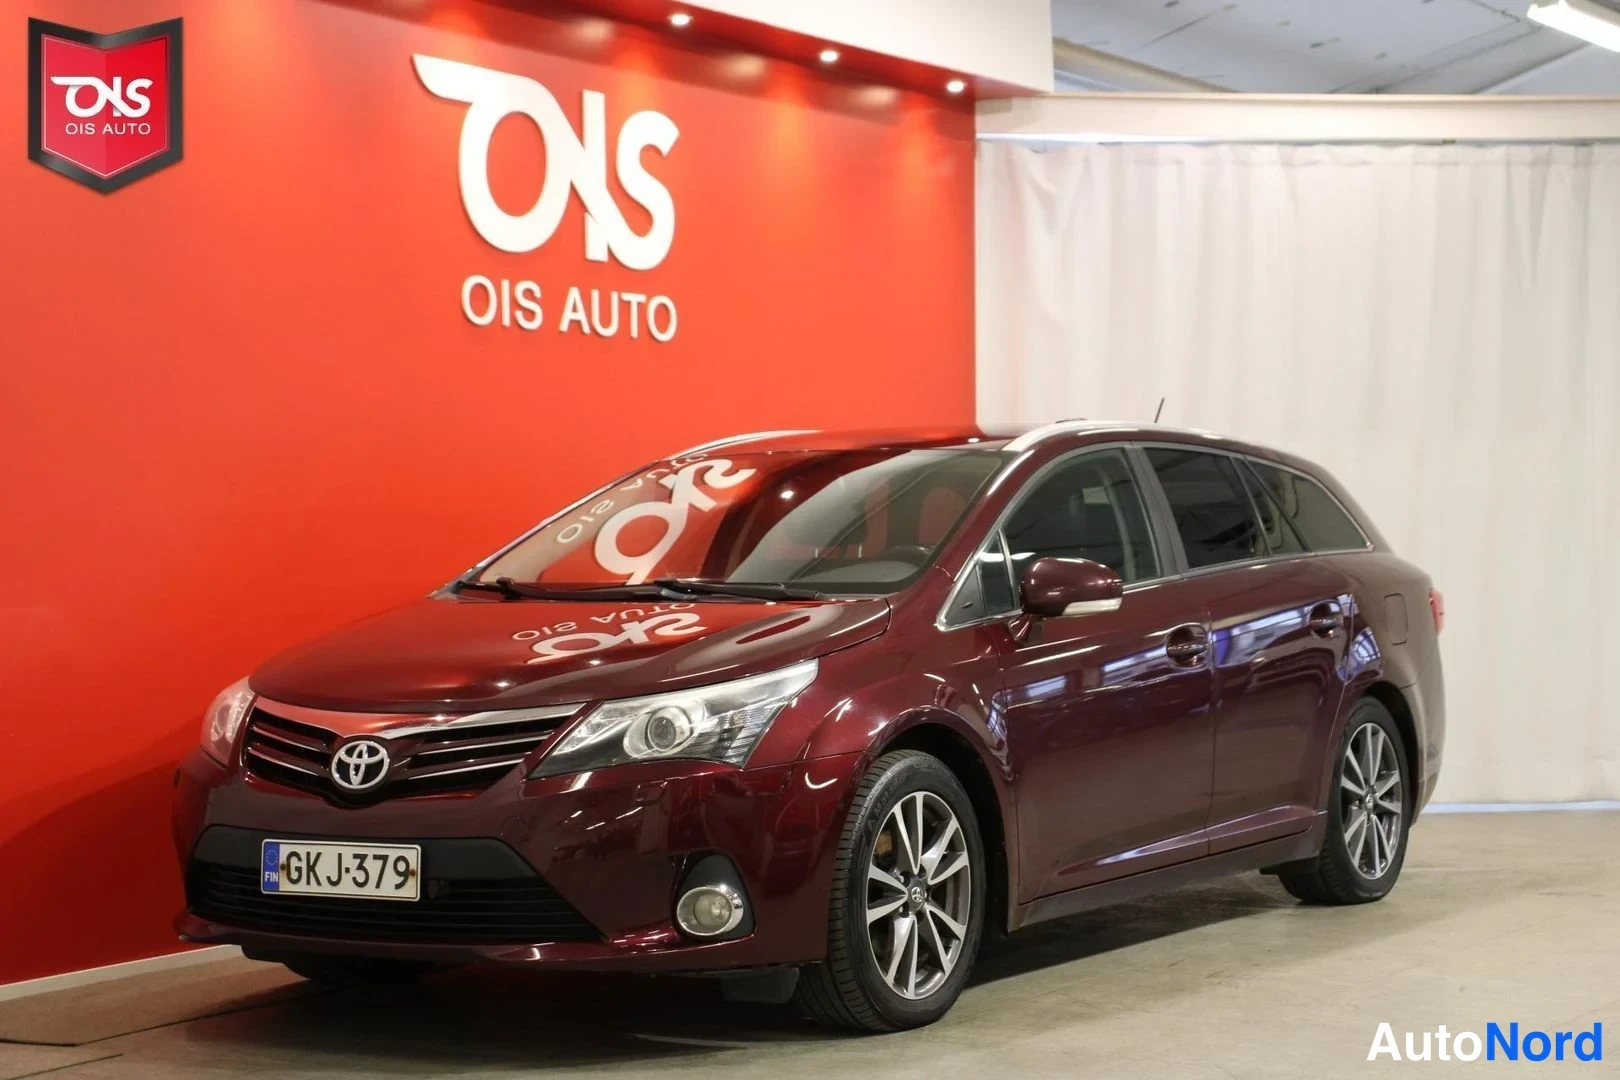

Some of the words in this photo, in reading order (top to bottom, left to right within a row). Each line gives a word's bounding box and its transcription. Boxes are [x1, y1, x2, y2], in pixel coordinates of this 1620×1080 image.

[411, 53, 680, 270] OIS
[461, 274, 544, 331] OIS
[558, 286, 678, 342] AUTO
[264, 871, 279, 882] FIN
[286, 850, 410, 890] GKJ-379
